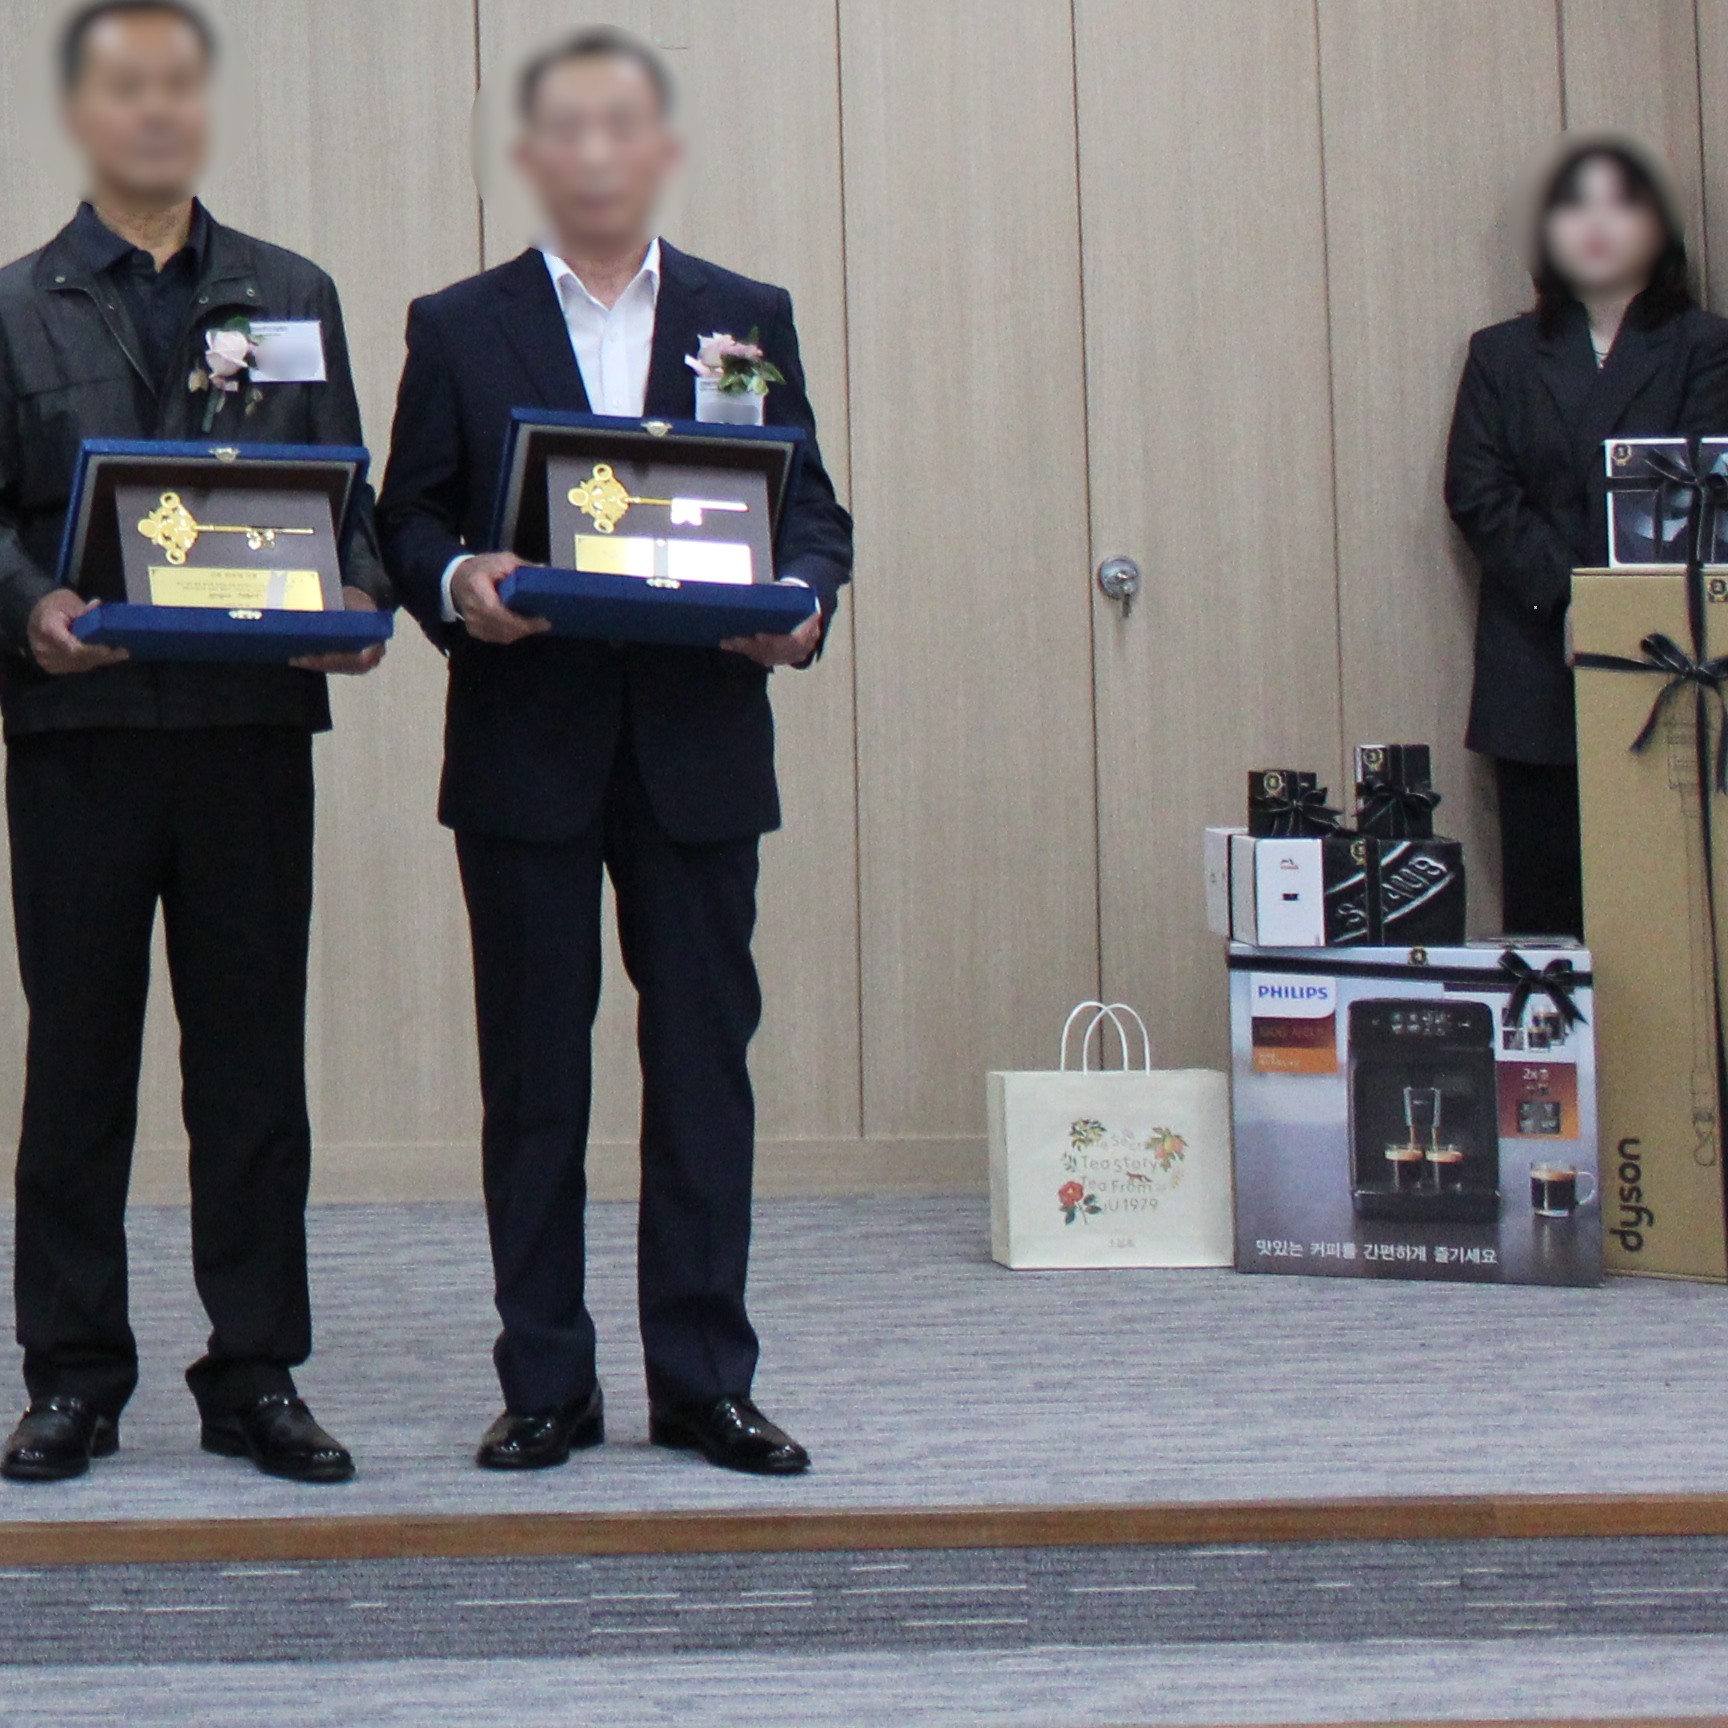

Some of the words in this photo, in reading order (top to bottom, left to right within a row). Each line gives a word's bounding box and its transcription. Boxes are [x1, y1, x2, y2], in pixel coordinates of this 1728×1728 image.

[1336, 856, 1448, 926] SAUB
[1258, 985, 1328, 1000] PHILIPS
[1124, 1197, 1158, 1212] 1979
[1609, 1138, 1654, 1252] dyson
[1255, 1239, 1304, 1257] 맛있는
[1310, 1241, 1357, 1260] 커피를
[1363, 1243, 1428, 1262] 간편하게
[1434, 1245, 1498, 1264] 즐기세요
